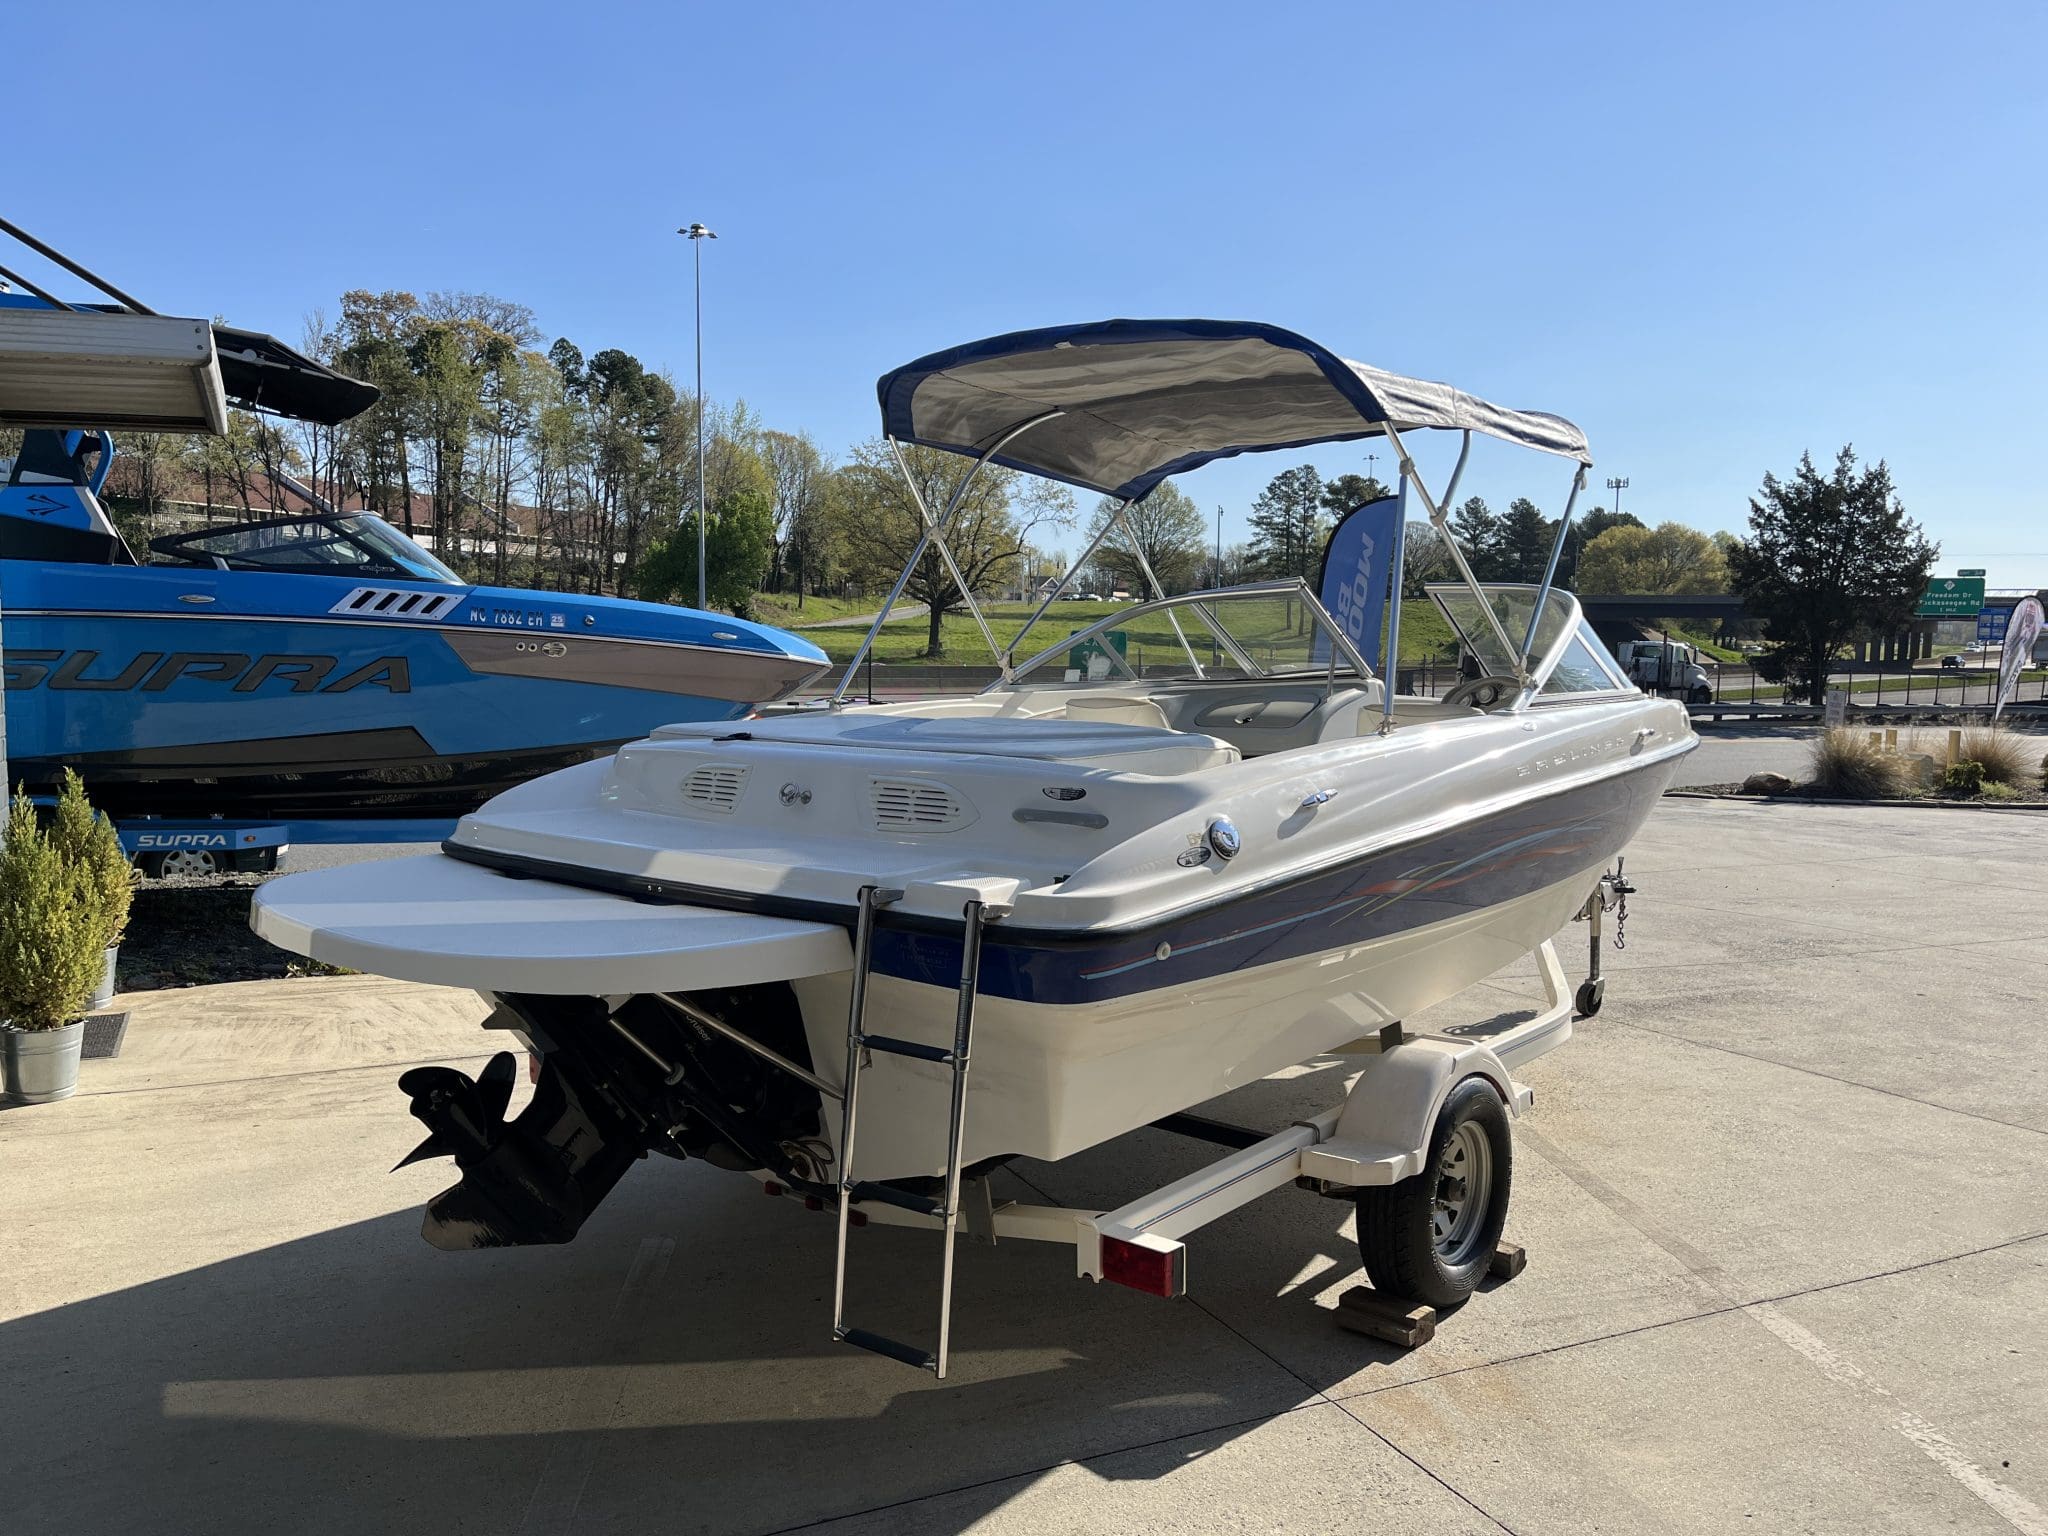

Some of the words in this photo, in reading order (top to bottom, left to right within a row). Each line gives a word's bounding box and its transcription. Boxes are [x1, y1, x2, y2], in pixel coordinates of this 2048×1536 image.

[1348, 532, 1375, 651] MOO
[470, 607, 486, 622] NC
[494, 608, 522, 625] 7882
[528, 611, 543, 626] EH
[2, 649, 411, 693] SUPRA
[137, 834, 227, 847] SUPRA
